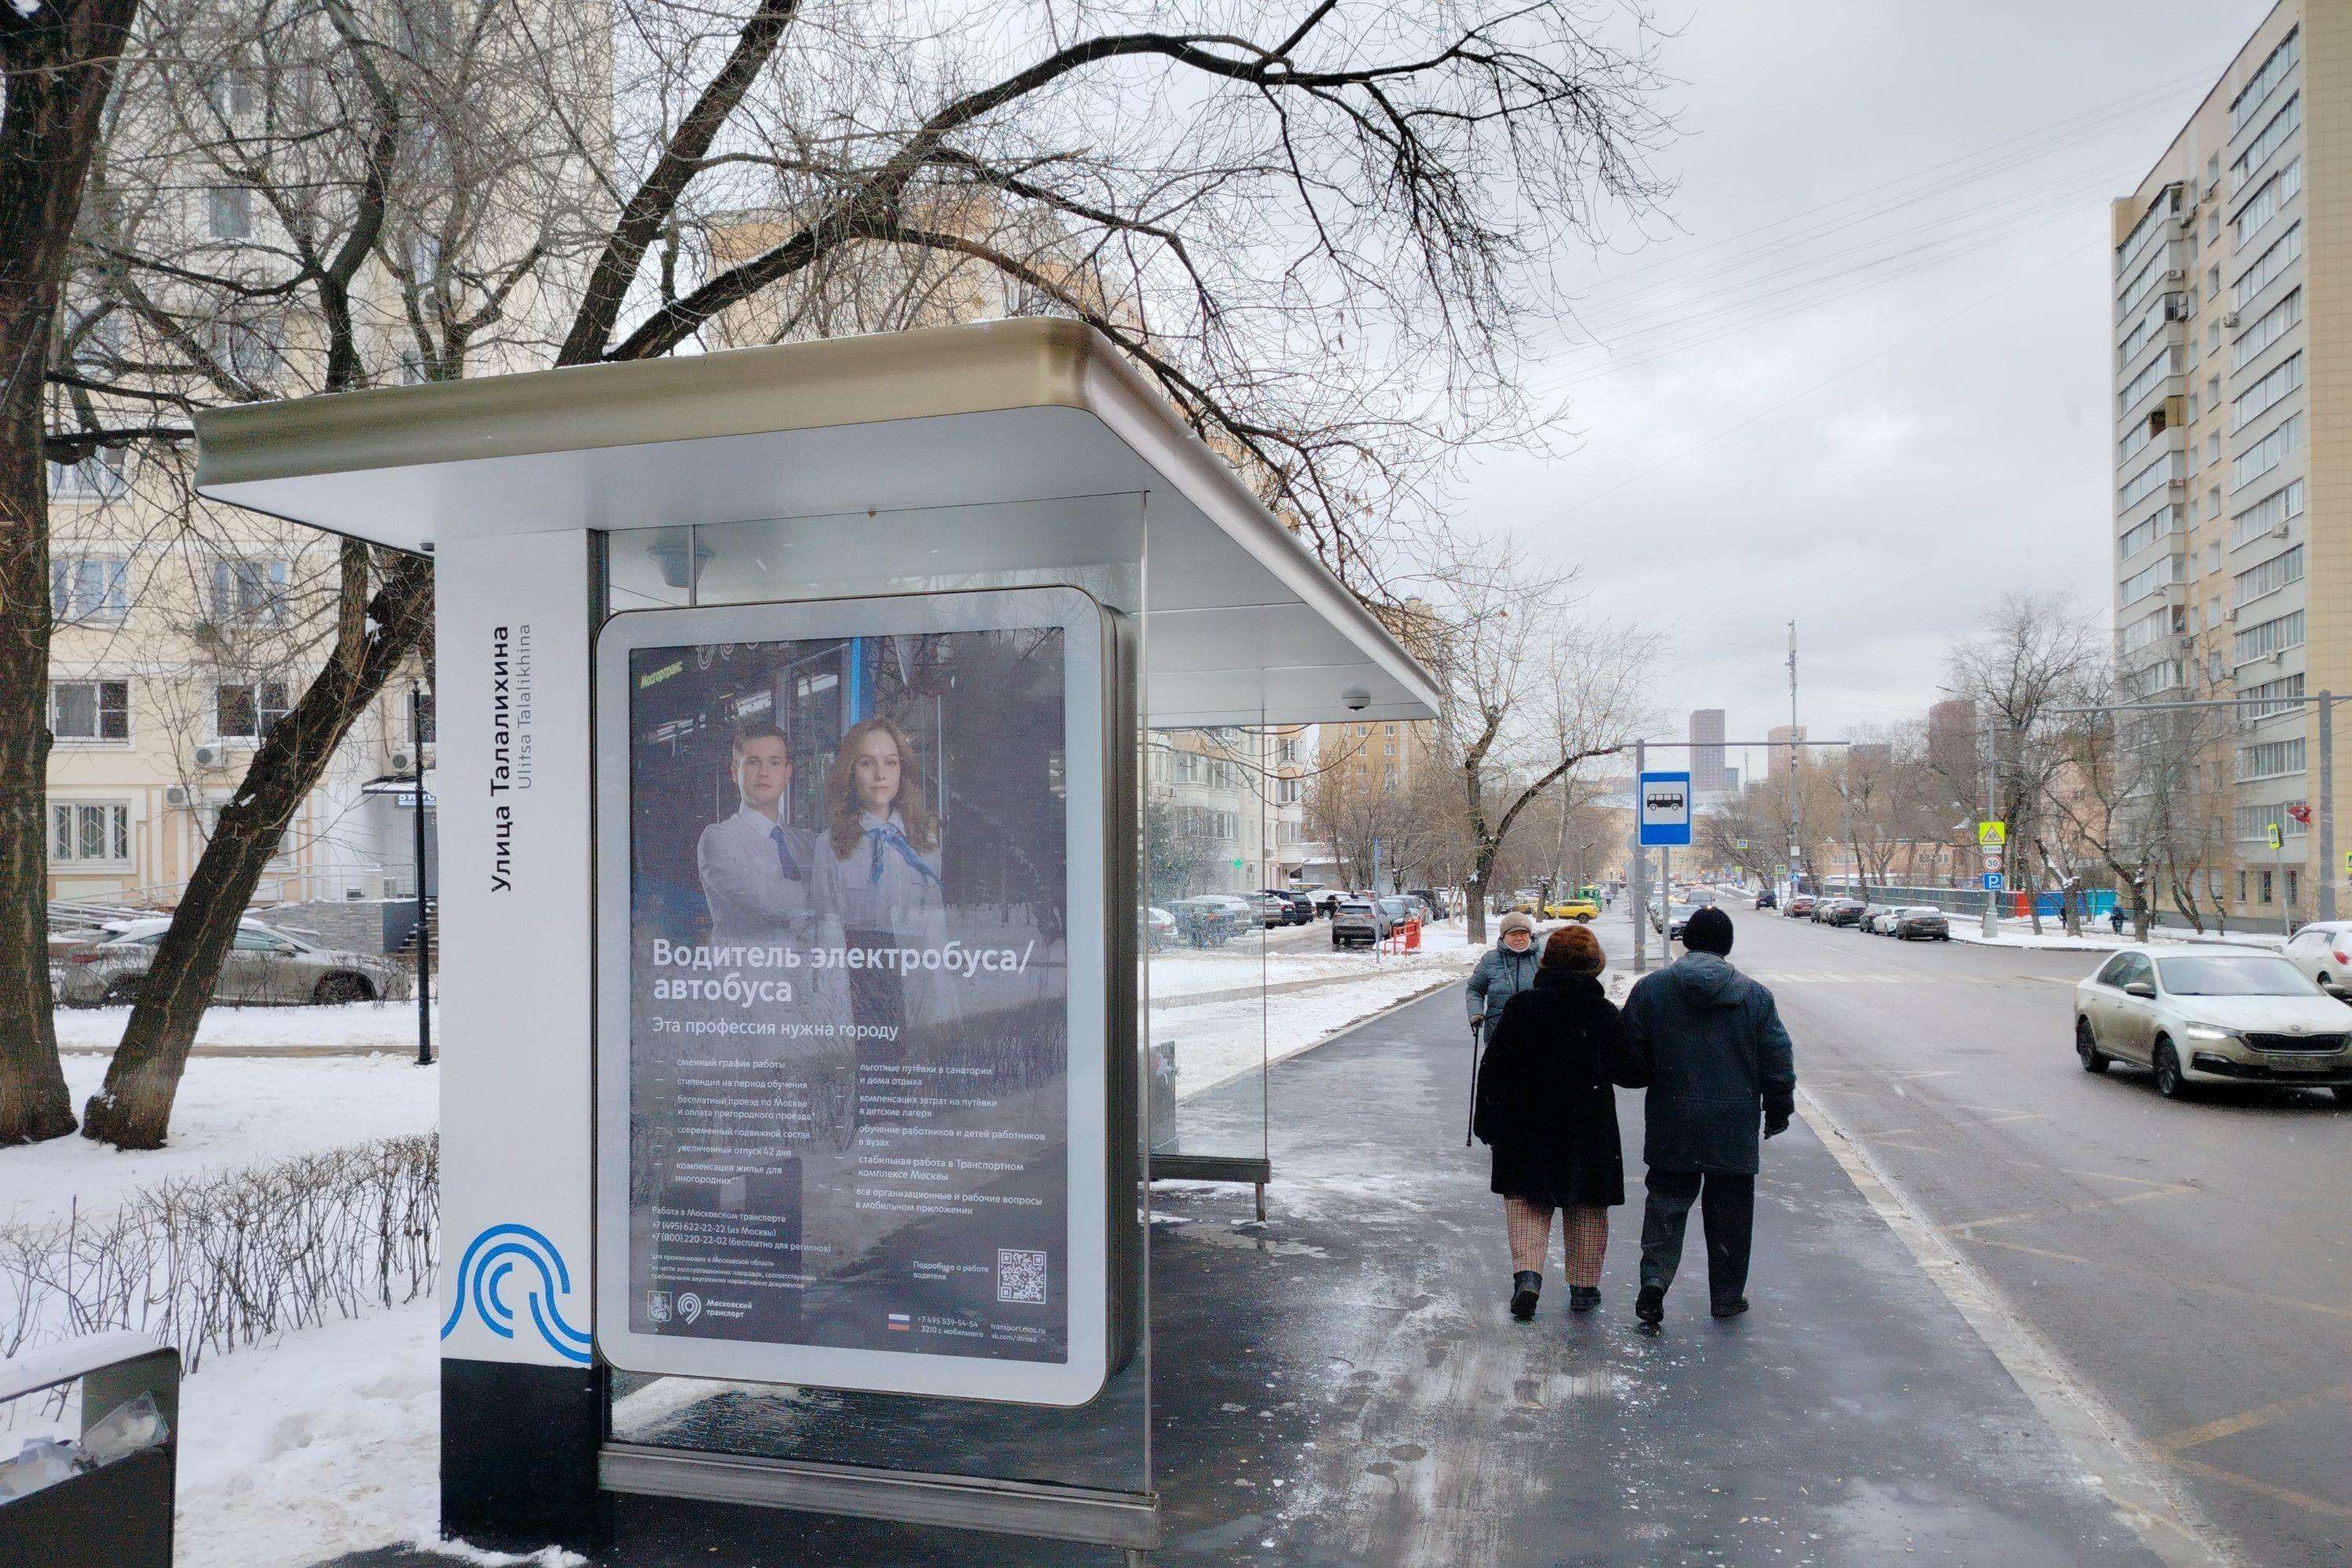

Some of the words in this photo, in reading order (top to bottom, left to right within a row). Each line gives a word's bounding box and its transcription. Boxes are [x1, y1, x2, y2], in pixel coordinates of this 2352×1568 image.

[517, 624, 531, 729] Talalikhina
[641, 661, 682, 689] Мосгортранс
[491, 626, 510, 797] Талалихина
[518, 734, 532, 789] Ulitsa
[492, 806, 514, 893] Улица
[653, 938, 801, 971] Водитель
[810, 940, 1036, 978] электробуса/
[653, 973, 792, 1007] автобуса
[652, 1018, 681, 1032] Эта
[685, 1018, 775, 1036] профессия
[781, 1021, 833, 1040] нужна
[839, 1025, 898, 1041] городу
[677, 1058, 716, 1067] сменный
[719, 1059, 750, 1069] график
[753, 1059, 785, 1069] работы
[860, 1064, 899, 1073] льготные
[902, 1065, 936, 1074] путёвки
[735, 1081, 765, 1090] период
[768, 1081, 808, 1090] обучения
[867, 1077, 889, 1086] дома
[892, 1078, 922, 1087] отдыха
[677, 1094, 726, 1106] бесплатный
[729, 1098, 759, 1107] проезд
[774, 1099, 807, 1108] Москве
[860, 1095, 917, 1105] компенсация
[920, 1098, 947, 1106] затрат
[963, 1098, 997, 1108] путёвки
[715, 1111, 773, 1120] пригородного
[866, 1109, 900, 1117] детские
[902, 1109, 931, 1118] лагеря
[677, 1127, 732, 1136] современный
[735, 1129, 780, 1139] подвижной
[859, 1126, 900, 1134] обучение
[902, 1127, 954, 1137] работников
[964, 1130, 989, 1139] детей
[992, 1131, 1045, 1141] работников
[677, 1145, 731, 1154] увеличенный
[734, 1147, 761, 1156] отпуск
[677, 1162, 734, 1173] компенсация
[737, 1165, 764, 1174] жилья
[767, 1167, 782, 1176] для
[859, 1155, 910, 1165] стабильная
[913, 1159, 946, 1168] работа
[956, 1160, 1023, 1171] Транспортном
[858, 1170, 908, 1179] комплексе
[910, 1171, 948, 1181] Москвы
[873, 1189, 952, 1201] организационные
[963, 1193, 1000, 1204] рабочие
[1003, 1196, 1043, 1206] вопросы
[863, 1200, 914, 1211] мобильном
[916, 1204, 972, 1214] приложении
[652, 1207, 678, 1216] Работа
[688, 1209, 738, 1219] Московском
[739, 1214, 786, 1223] транспорте
[653, 1221, 660, 1229] +7
[662, 1221, 682, 1231] (495)
[684, 1223, 725, 1233] 622-22-22
[728, 1225, 739, 1234] (из
[742, 1226, 776, 1237] Москвы)
[652, 1233, 659, 1242] +7
[661, 1233, 682, 1243] (800)
[684, 1234, 727, 1246] 220-22-02
[729, 1237, 773, 1249] (бесплатно
[790, 1243, 830, 1253] регионов)
[712, 1256, 749, 1265] Московской
[913, 1261, 954, 1272] Подробнее
[706, 1299, 752, 1309] Московский
[706, 1309, 744, 1319] транспорт
[942, 1318, 978, 1327] 539-54-54
[991, 1323, 1045, 1334] transport.mos.ru
[943, 1328, 983, 1338] мобильного
